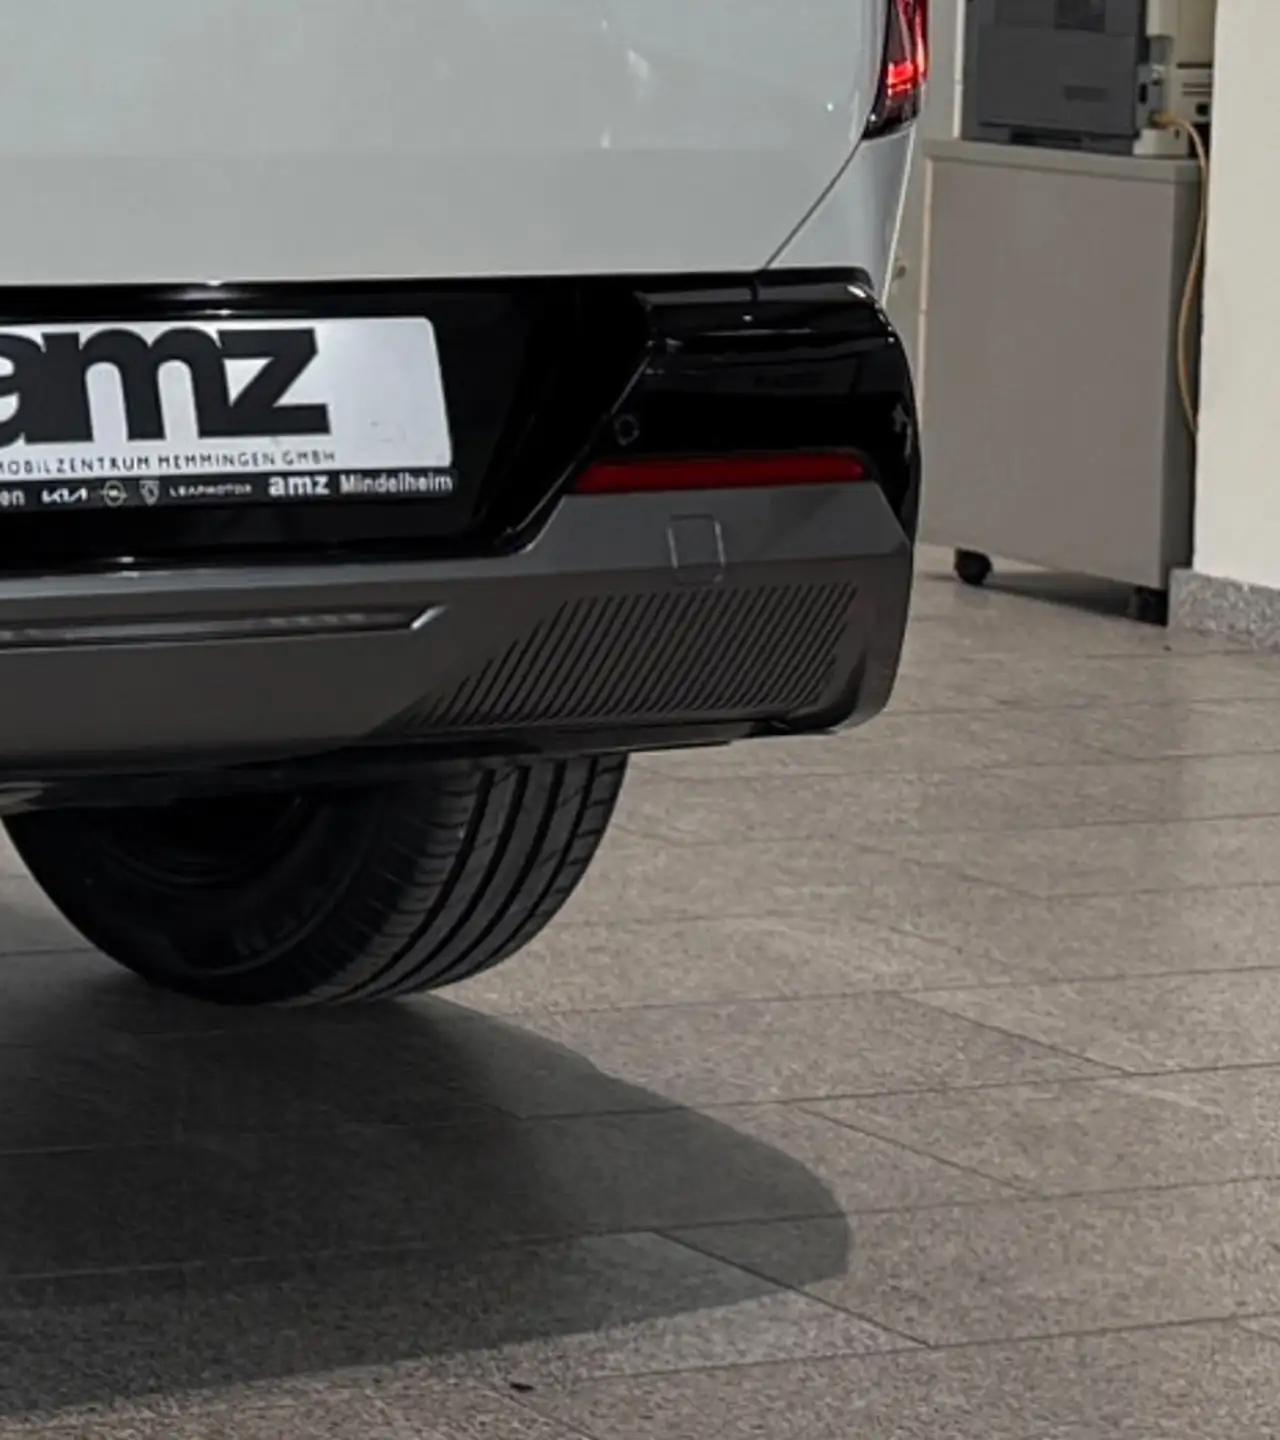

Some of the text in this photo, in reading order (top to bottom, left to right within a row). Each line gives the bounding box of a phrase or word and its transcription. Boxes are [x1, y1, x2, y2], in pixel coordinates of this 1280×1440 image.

[158, 452, 275, 469] MEMMINGEN
[268, 474, 330, 498] amz
[340, 471, 453, 495] Mindelheim
